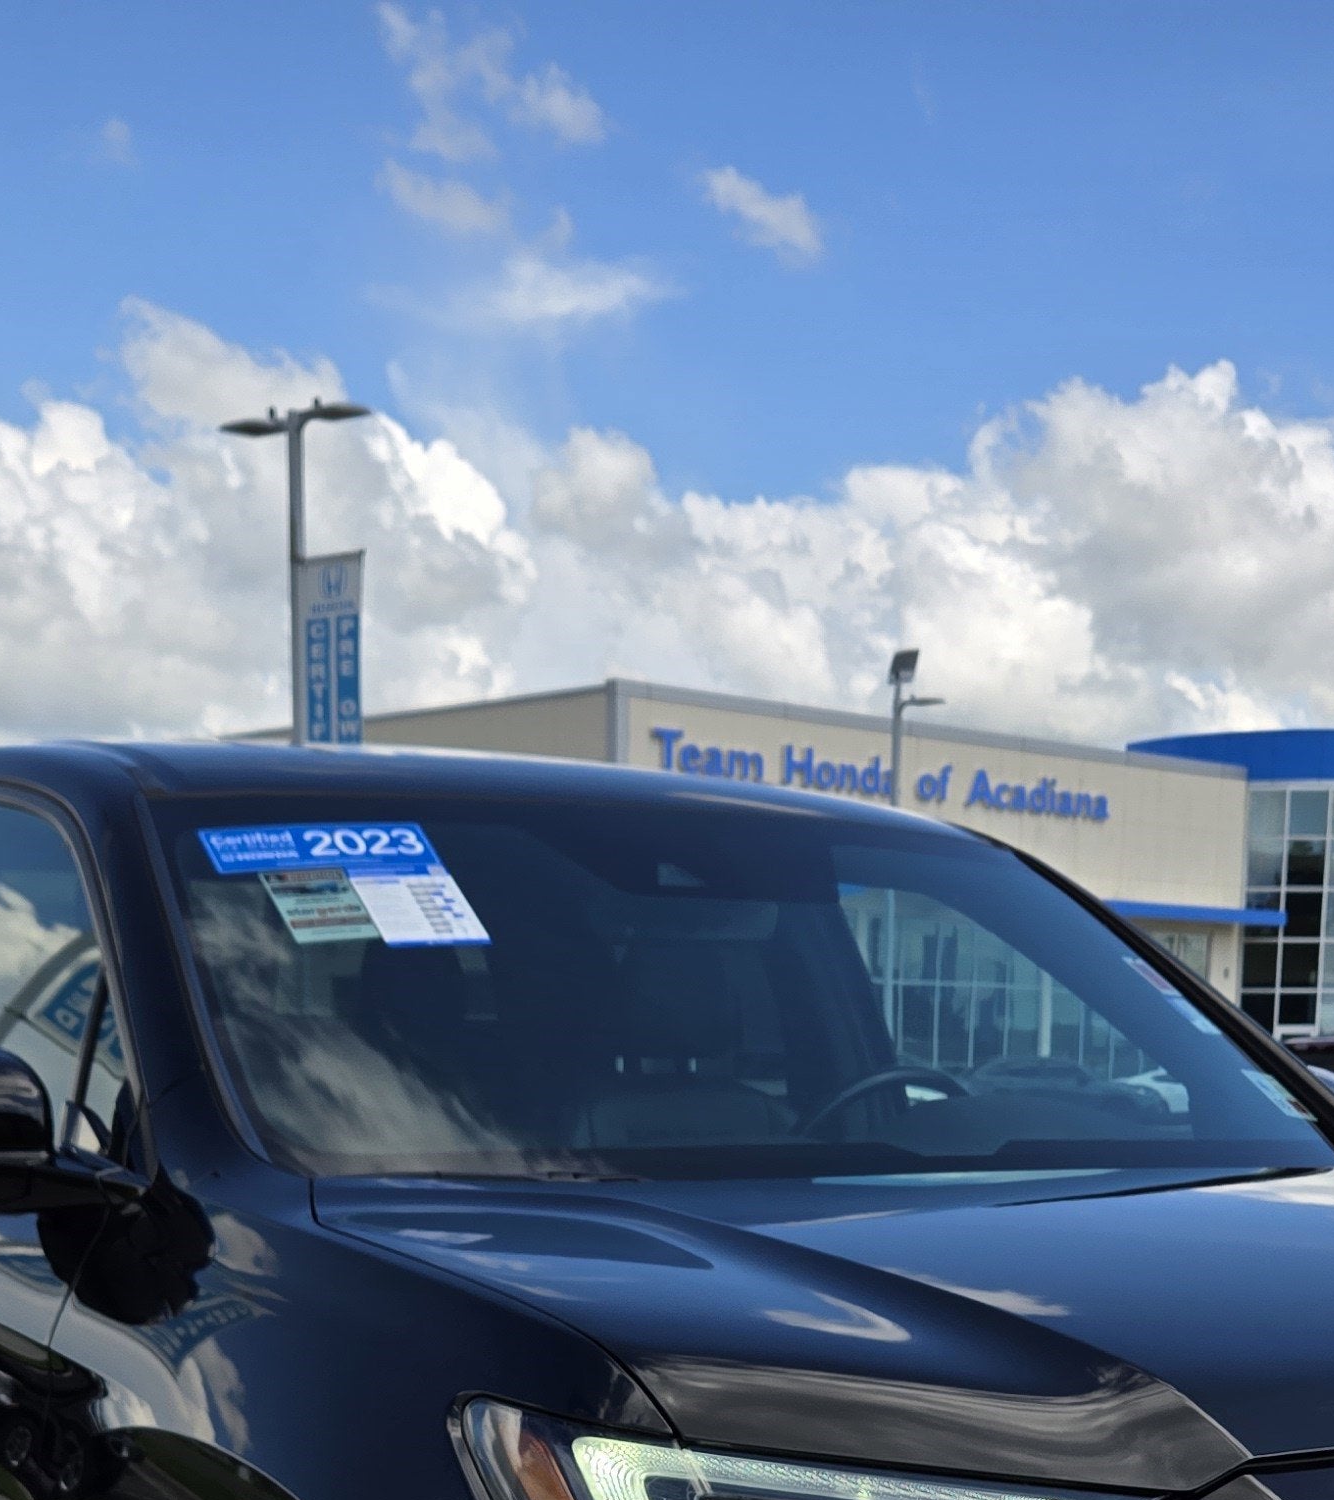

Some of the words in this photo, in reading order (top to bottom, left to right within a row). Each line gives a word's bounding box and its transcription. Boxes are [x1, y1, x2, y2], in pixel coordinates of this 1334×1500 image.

[651, 727, 764, 779] Team
[917, 765, 952, 802] of
[966, 768, 1109, 821] Acadiana
[210, 830, 293, 847] Certified
[302, 828, 425, 857] 2023
